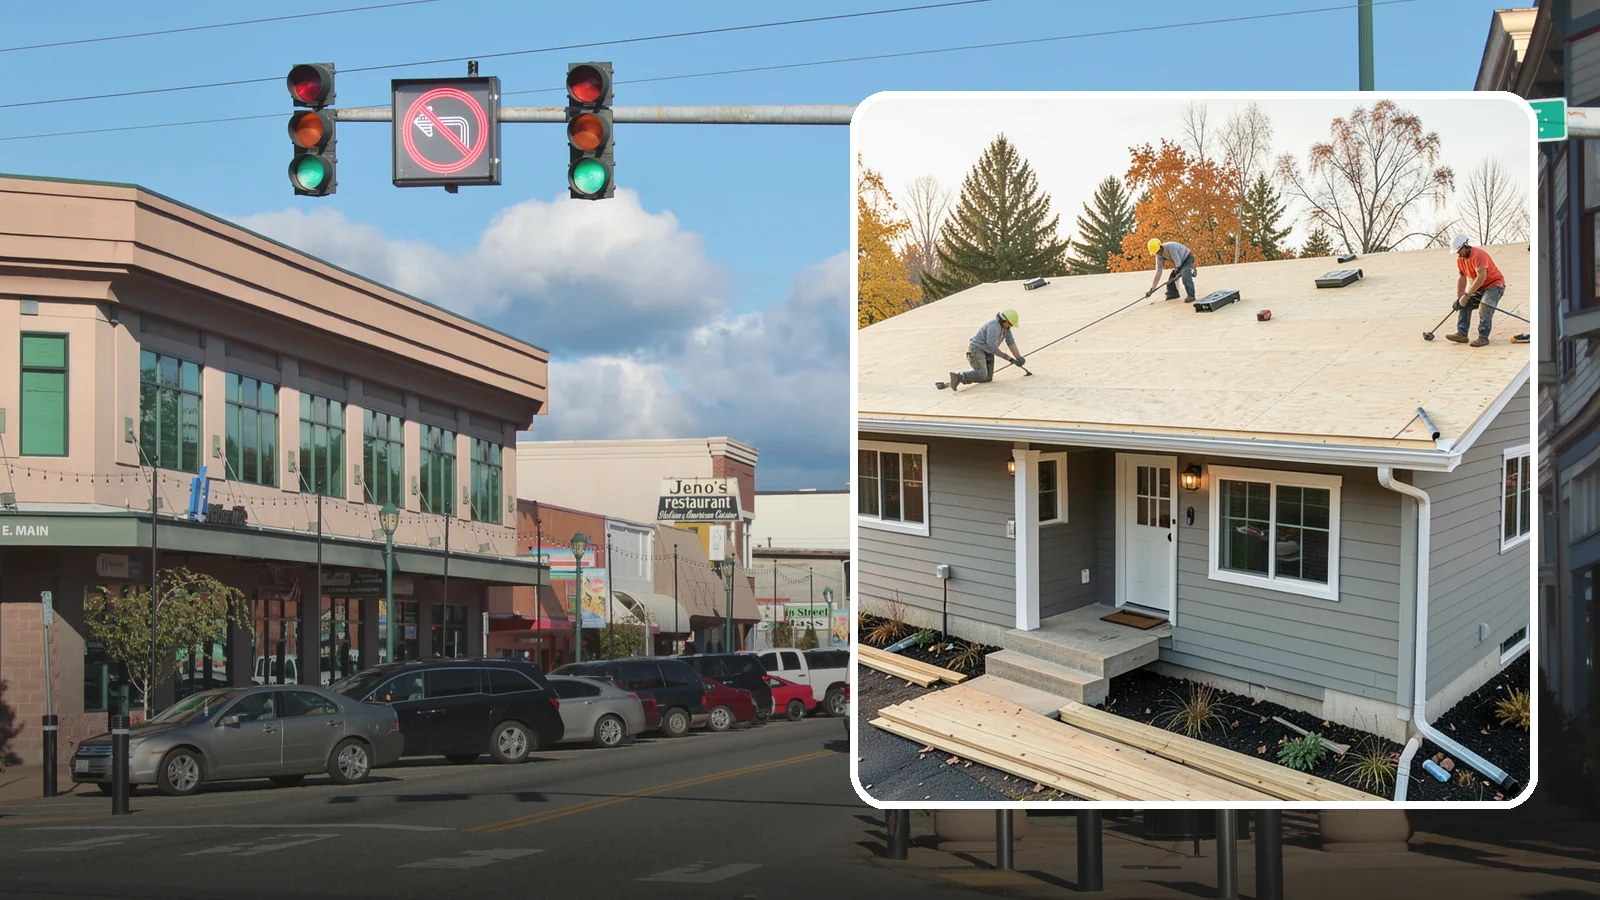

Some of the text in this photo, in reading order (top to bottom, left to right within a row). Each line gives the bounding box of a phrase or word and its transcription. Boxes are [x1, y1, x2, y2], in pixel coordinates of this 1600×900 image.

[670, 480, 727, 494] Jeno's
[665, 497, 731, 509] restaurant
[659, 510, 681, 519] Italian
[686, 510, 714, 519] American
[715, 510, 737, 519] Cuisine
[2, 525, 49, 536] E. MAIN
[797, 608, 828, 617] Street
